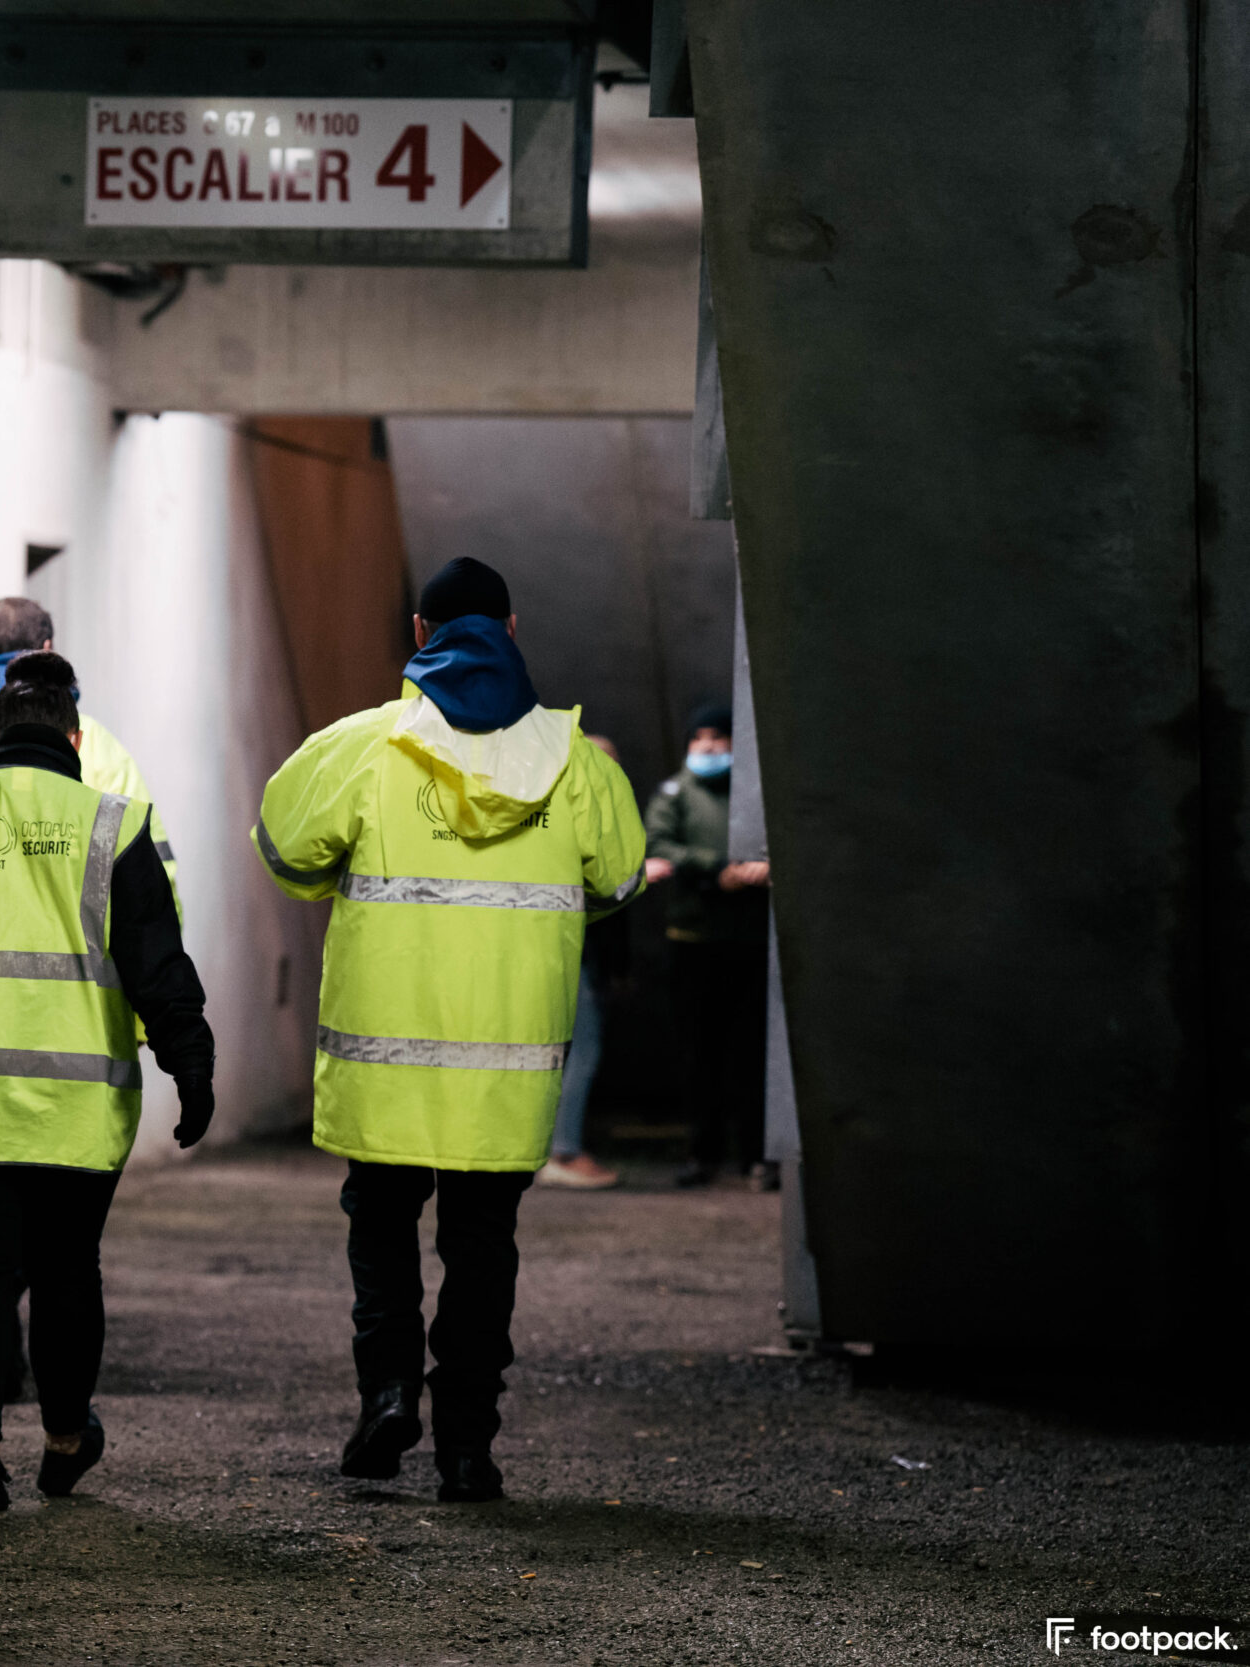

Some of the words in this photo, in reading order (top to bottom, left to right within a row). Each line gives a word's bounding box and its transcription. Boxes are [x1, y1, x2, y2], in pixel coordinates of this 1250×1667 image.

[97, 110, 187, 135] PLACES
[96, 147, 350, 202] ESCALIER
[376, 125, 436, 202] 4
[21, 821, 75, 839] OCTOPUS
